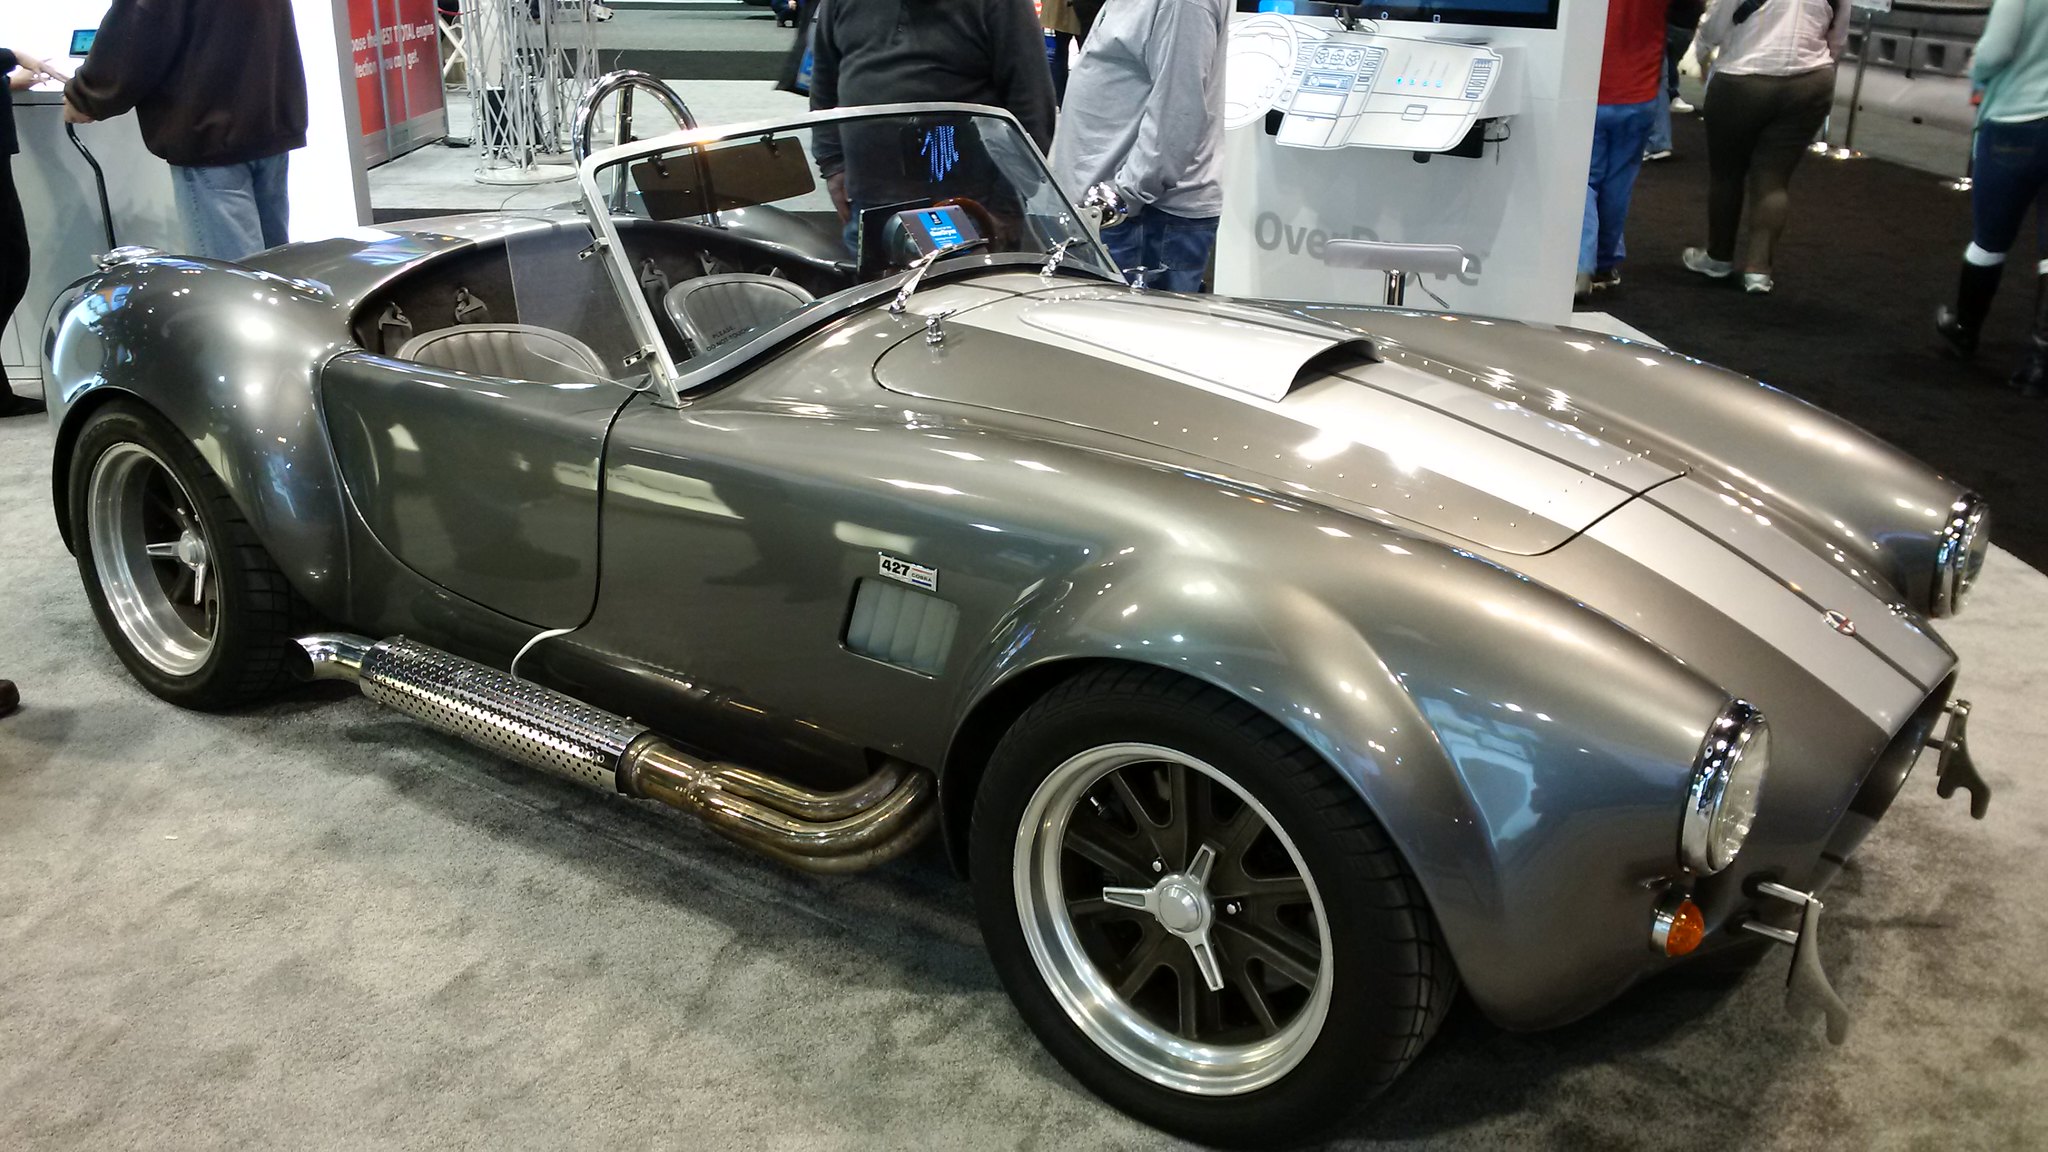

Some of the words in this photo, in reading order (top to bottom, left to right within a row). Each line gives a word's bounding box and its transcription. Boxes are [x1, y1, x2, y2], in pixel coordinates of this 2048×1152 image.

[379, 26, 393, 45] EST
[415, 20, 435, 41] engine
[706, 344, 716, 352] DO
[882, 559, 910, 576] 427
[911, 572, 933, 582] COBRA
